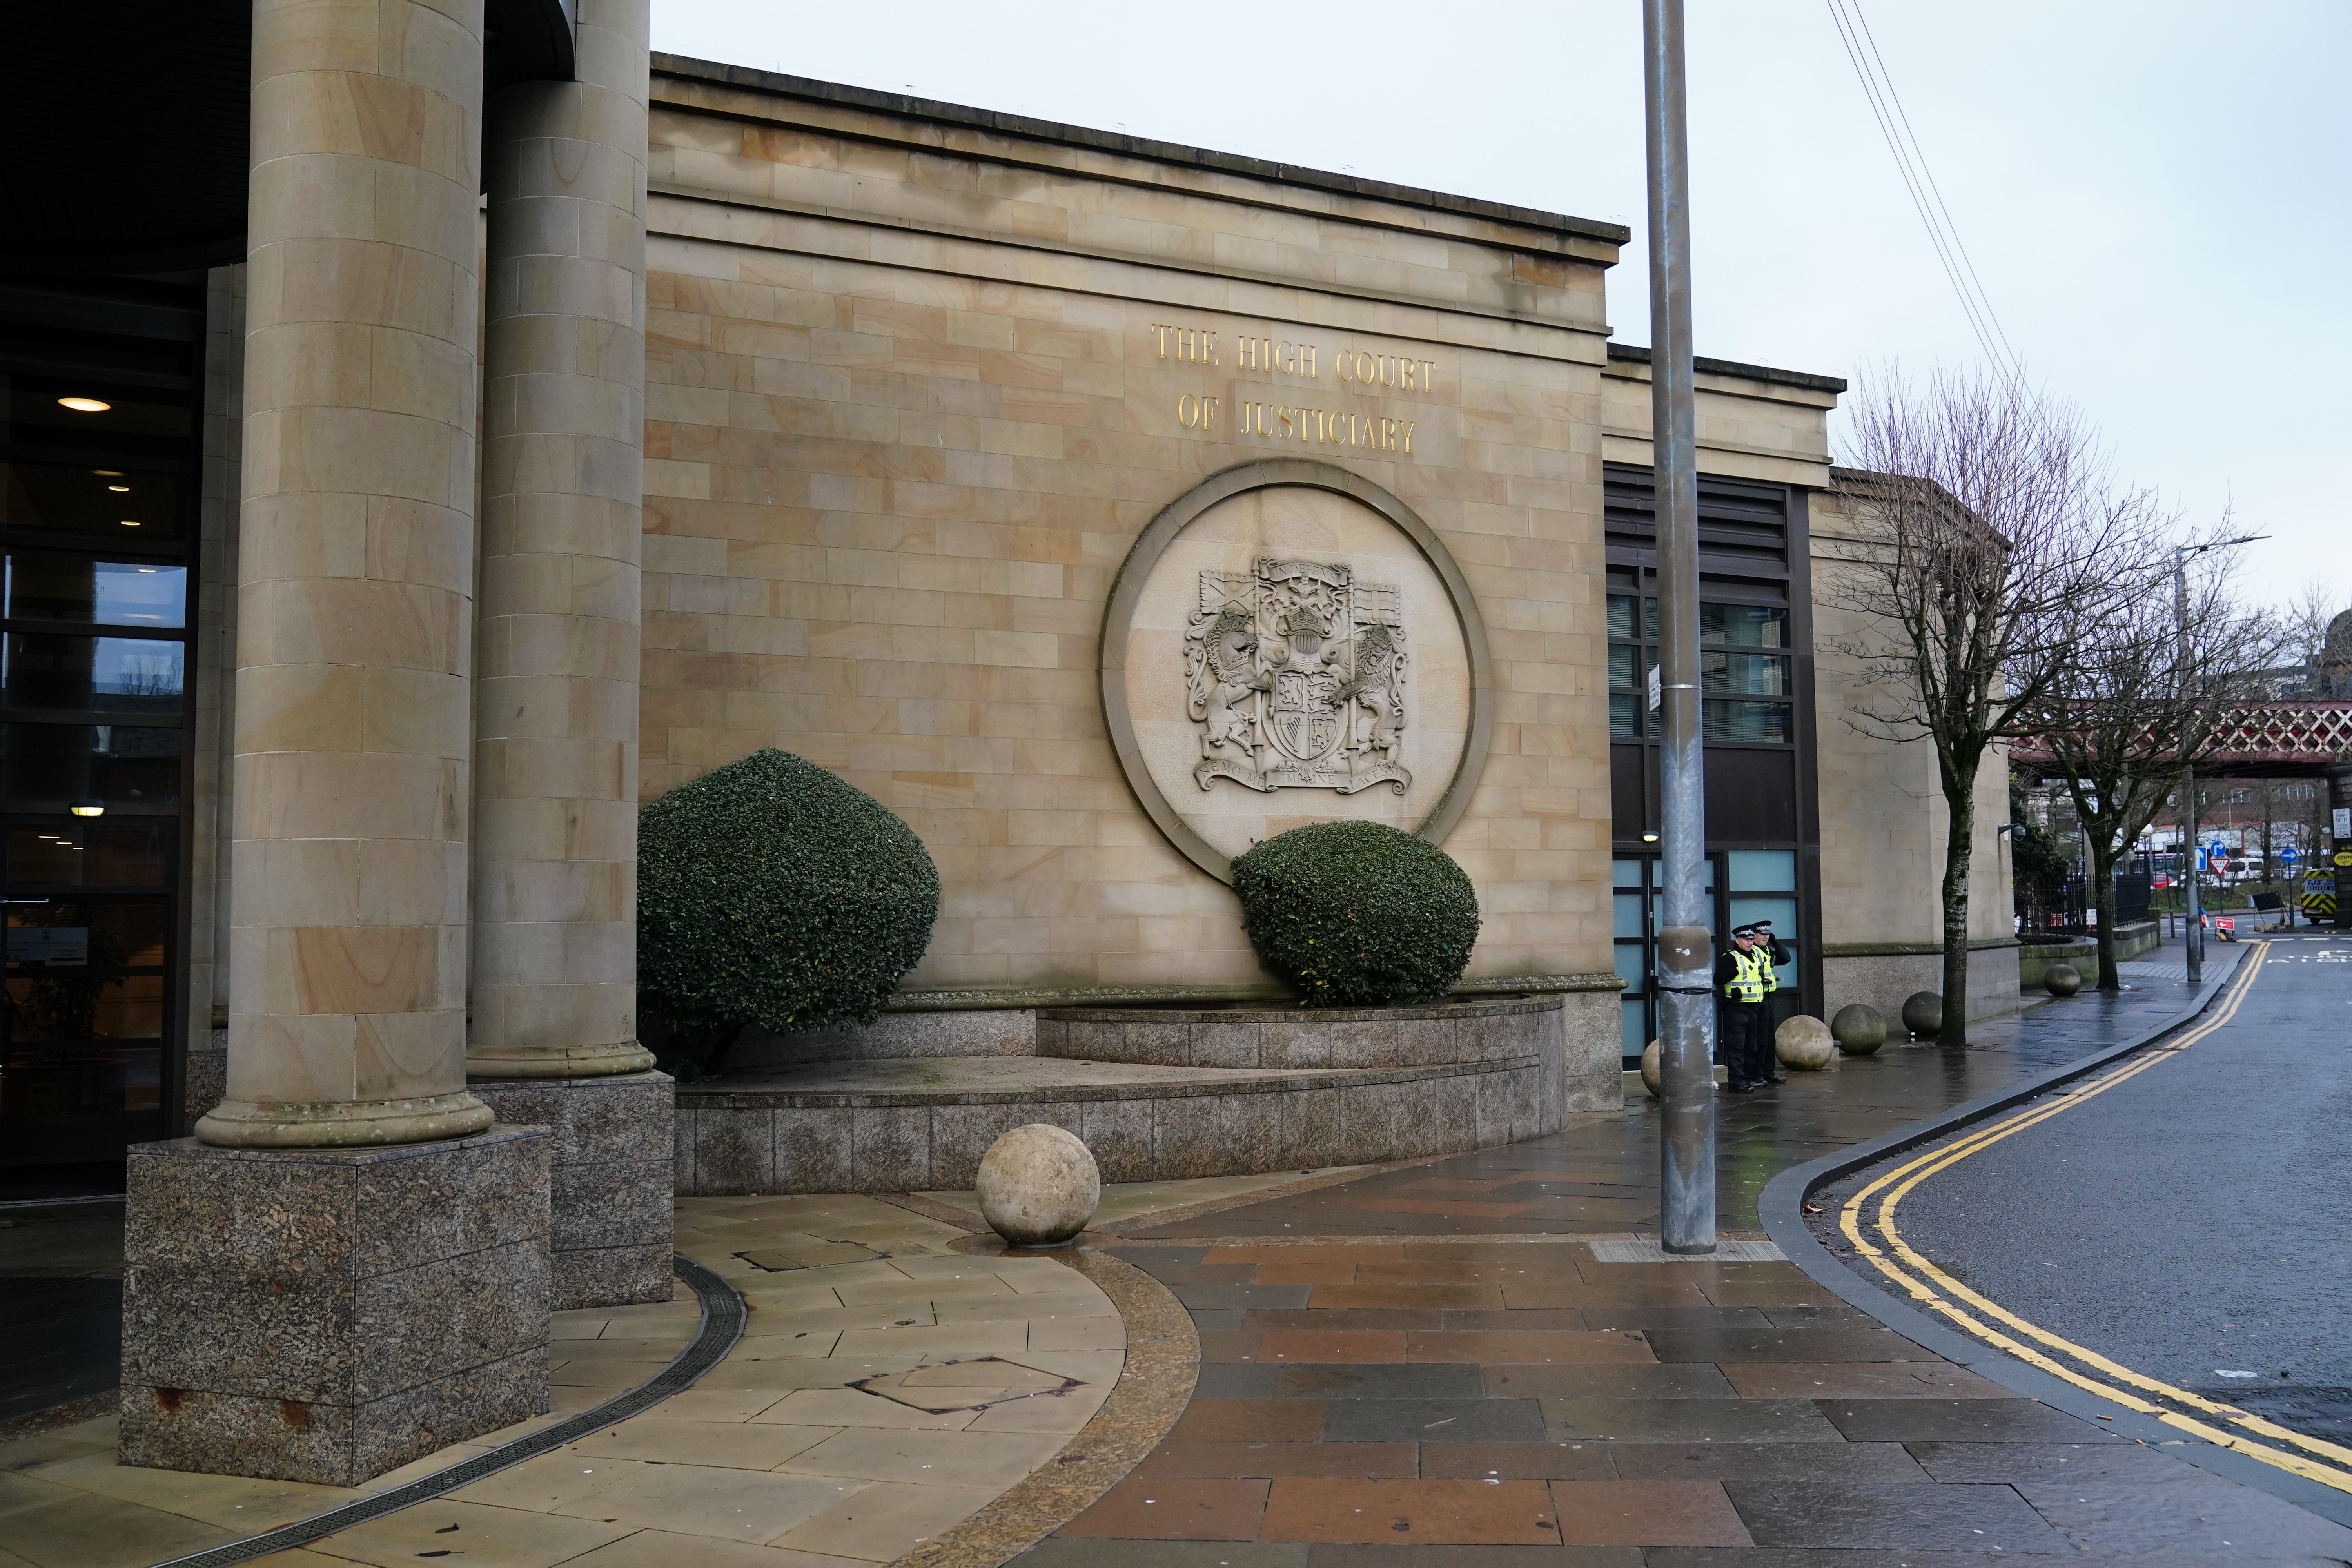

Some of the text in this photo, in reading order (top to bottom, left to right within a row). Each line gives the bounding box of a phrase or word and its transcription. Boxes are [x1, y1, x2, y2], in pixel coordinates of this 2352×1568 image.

[1152, 323, 1436, 392] THE HIGH COURT
[1178, 393, 1416, 452] OF JUSTICIARY
[1275, 564, 1337, 583] IN DEFENS
[1198, 762, 1241, 777] NEMO
[1246, 772, 1265, 787] ME
[1350, 767, 1406, 789] LACESSIT
